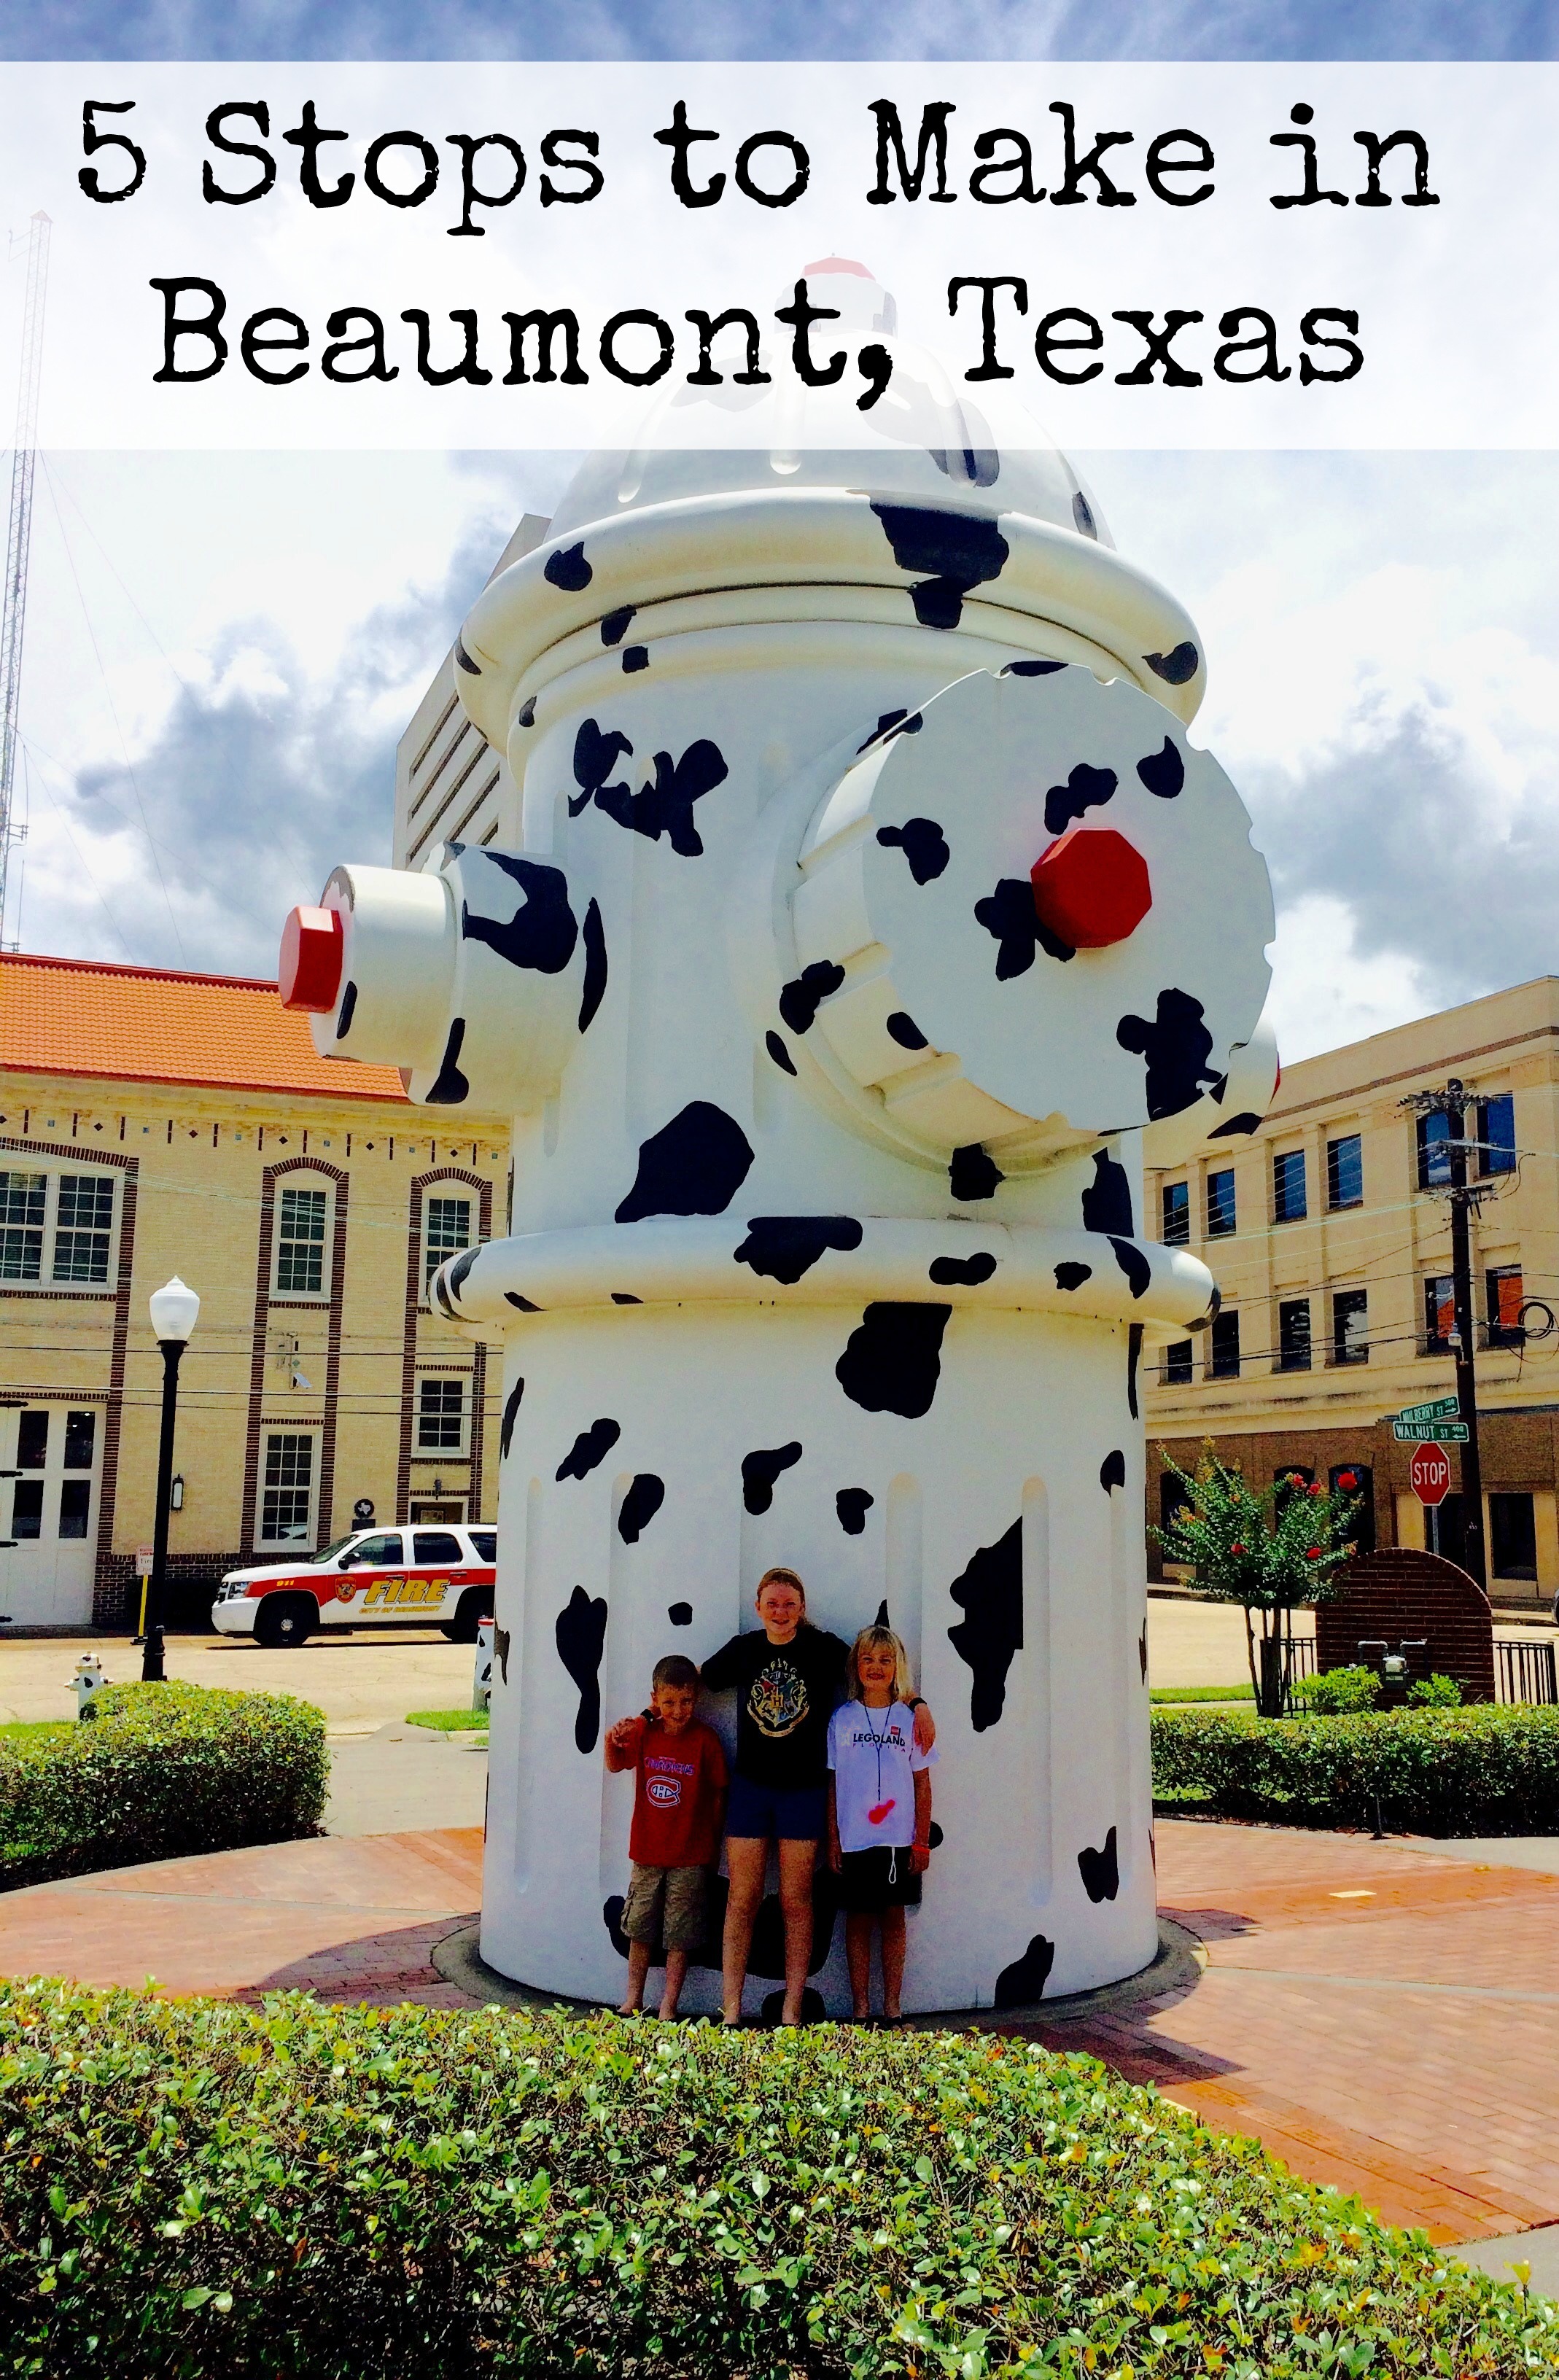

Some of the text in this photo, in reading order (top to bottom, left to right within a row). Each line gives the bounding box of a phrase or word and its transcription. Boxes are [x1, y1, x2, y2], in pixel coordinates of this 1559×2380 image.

[1402, 1404, 1434, 1422] MULBERRY
[1436, 1405, 1443, 1417] ST
[1396, 1424, 1434, 1439] WALNUT
[1440, 1428, 1448, 1439] ST
[1413, 1461, 1447, 1485] STOP
[364, 1579, 451, 1605] FIRE
[853, 1732, 906, 1746] LEGOLAND
